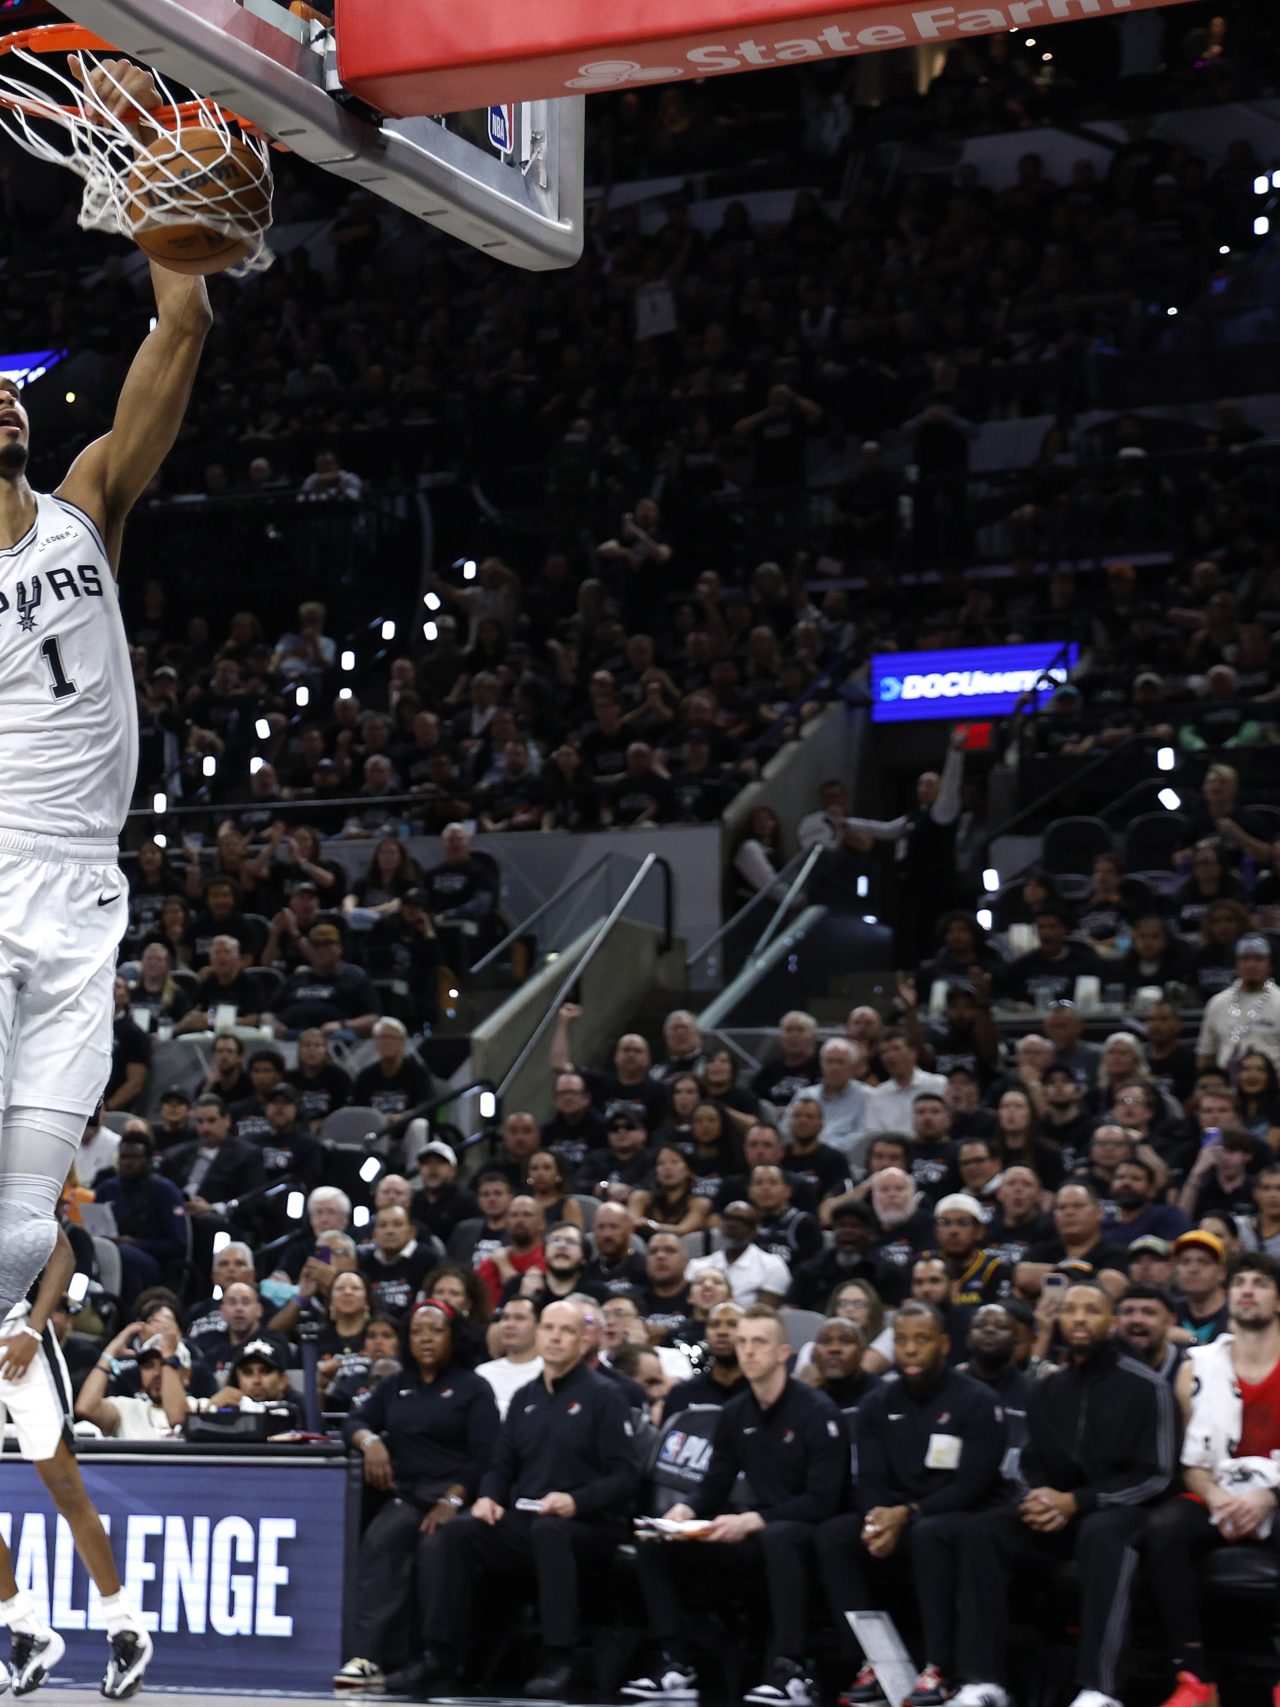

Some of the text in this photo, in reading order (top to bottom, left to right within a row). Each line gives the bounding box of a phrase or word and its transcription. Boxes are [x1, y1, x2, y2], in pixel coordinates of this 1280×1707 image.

[686, 25, 907, 73] State
[492, 113, 505, 141] NBA
[40, 634, 81, 701] 1
